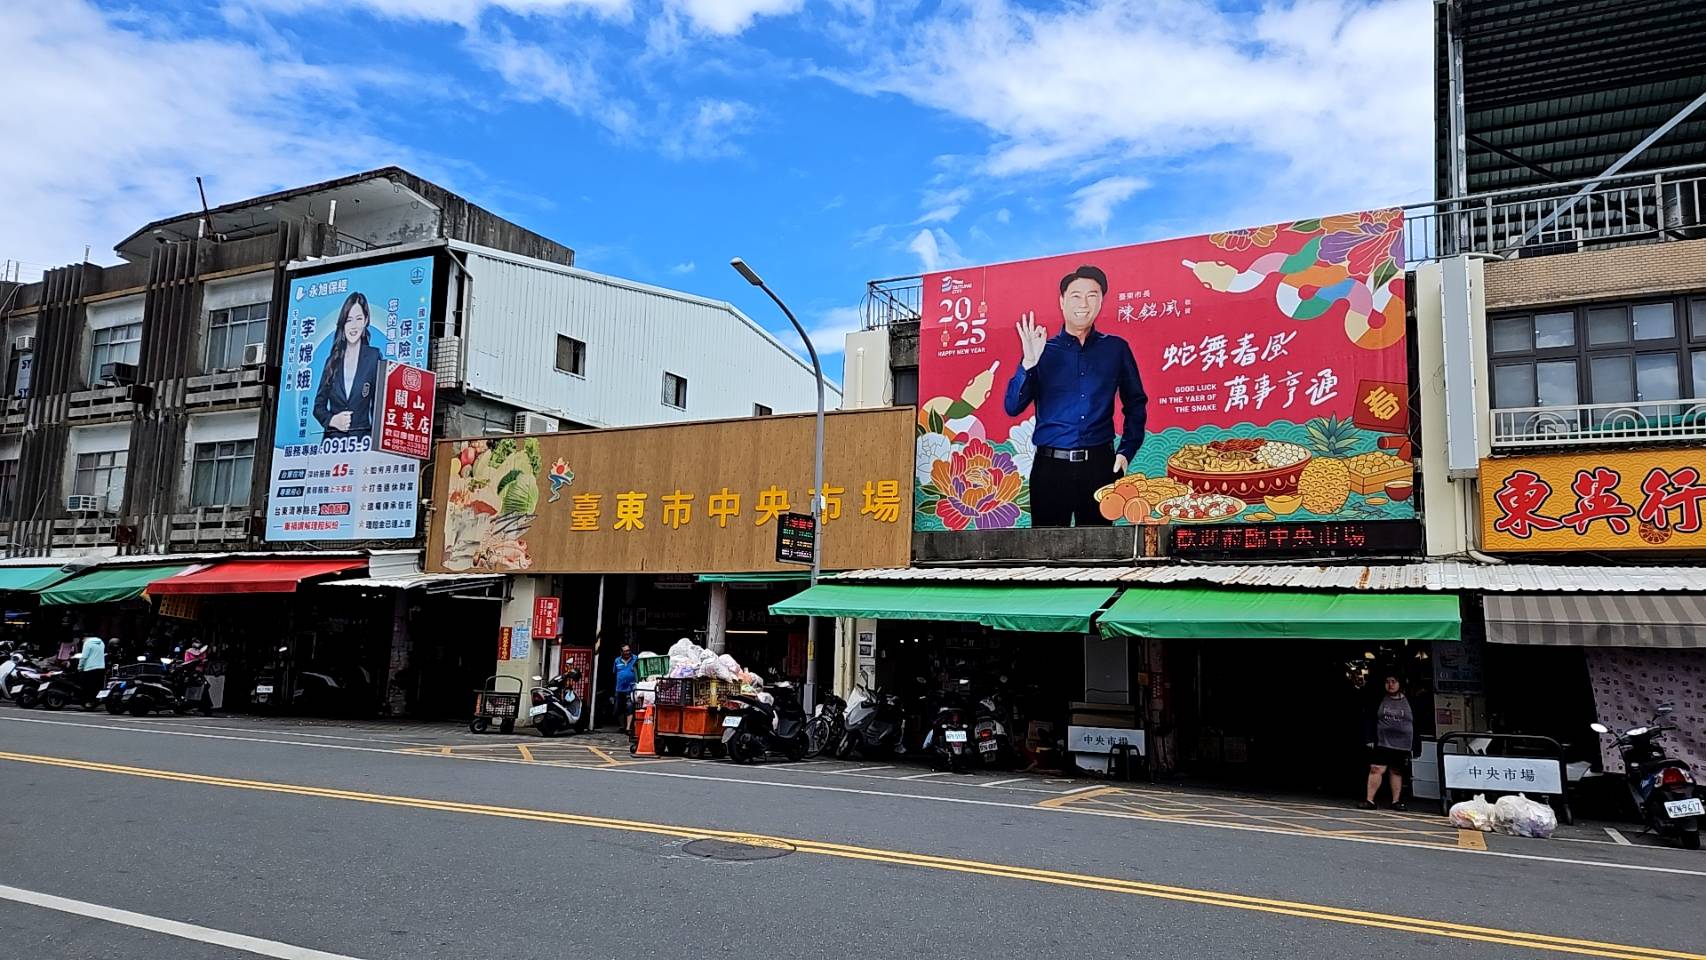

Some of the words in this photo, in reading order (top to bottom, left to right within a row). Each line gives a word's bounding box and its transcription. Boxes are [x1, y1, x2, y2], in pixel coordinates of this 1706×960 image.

[308, 279, 348, 297] 永旭保經
[1119, 289, 1151, 301] 臺東市長
[939, 297, 972, 323] 20
[398, 320, 412, 364] 保險
[954, 319, 987, 346] 25
[297, 319, 315, 389] 李嫦娥
[938, 349, 956, 357] HAPPY
[1161, 330, 1298, 372] 蛇舞春風
[394, 389, 425, 411] 關山
[1207, 393, 1217, 401] OF
[1224, 367, 1339, 414] 萬事亨通
[1191, 404, 1217, 412] SNAKE
[385, 408, 430, 435] 豆漿店
[569, 479, 901, 533] 臺東市中央市場
[1468, 765, 1536, 783] 中央市場
